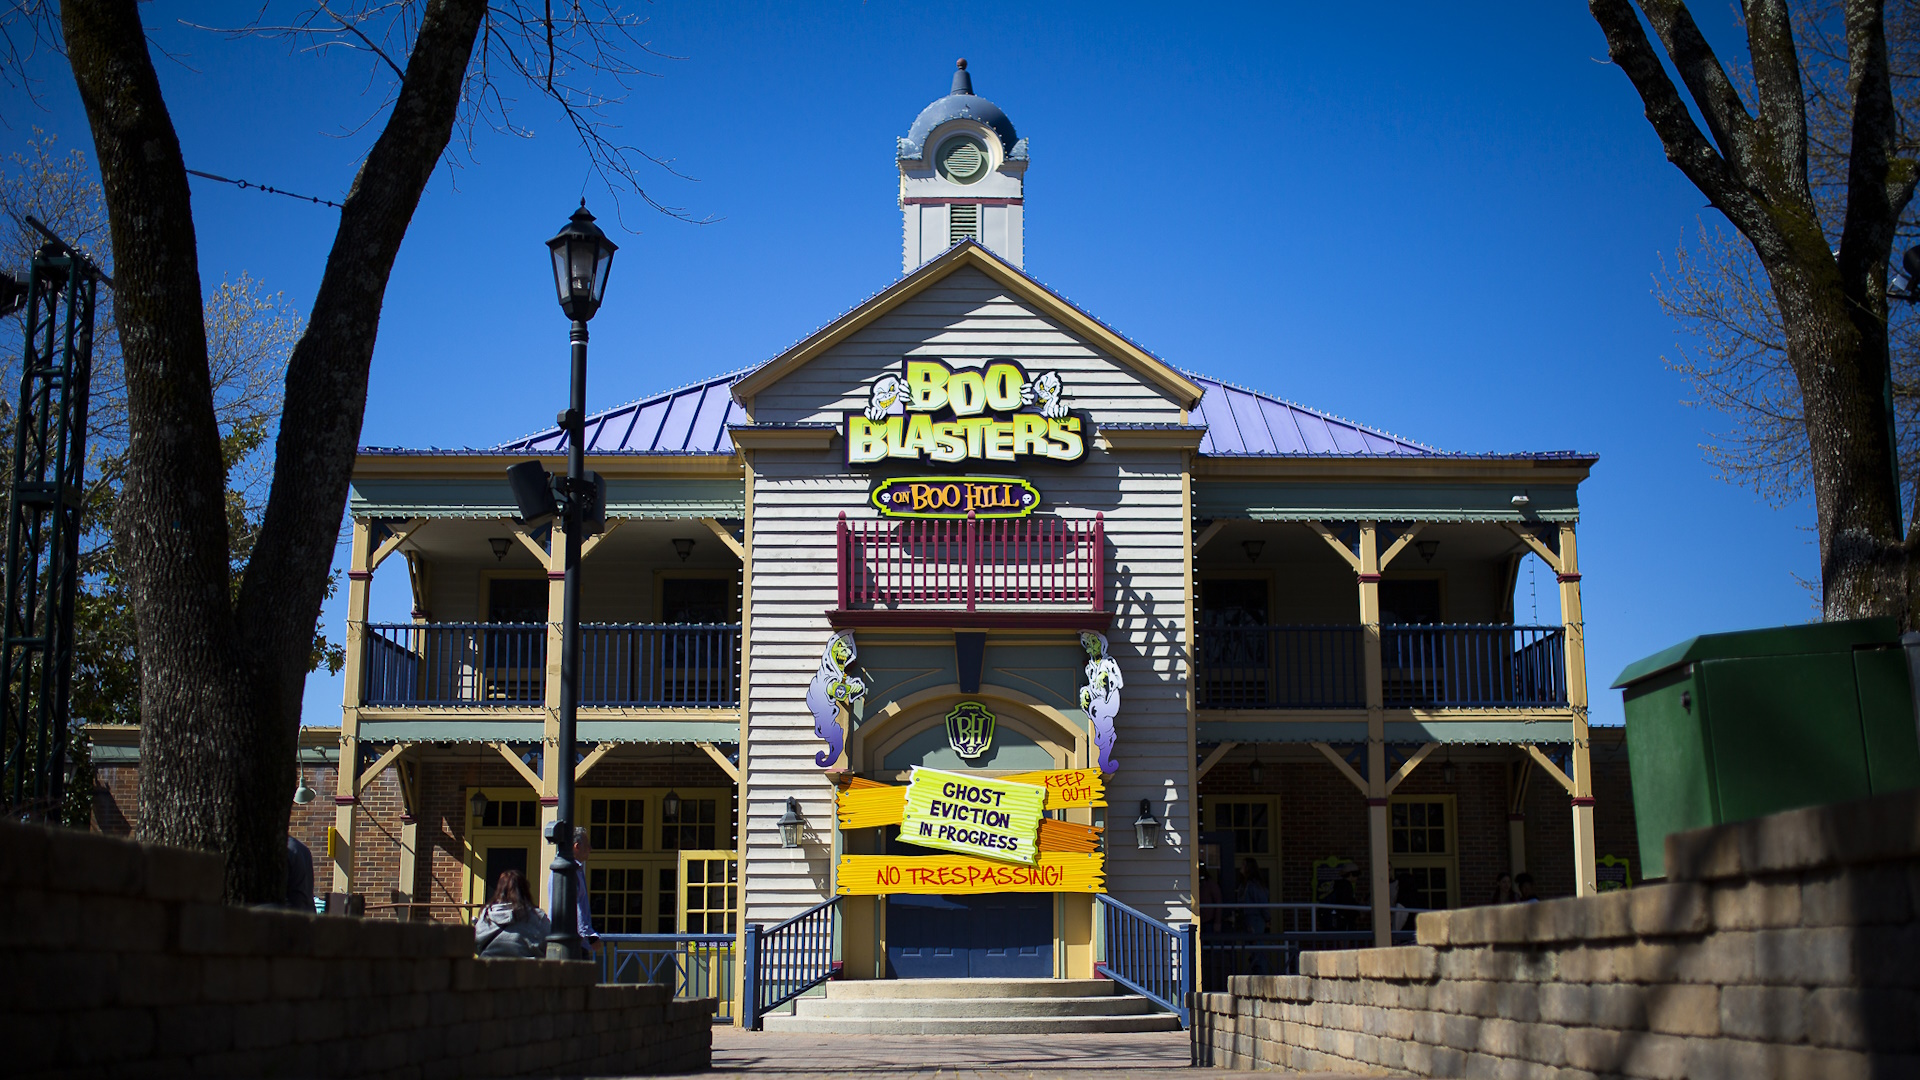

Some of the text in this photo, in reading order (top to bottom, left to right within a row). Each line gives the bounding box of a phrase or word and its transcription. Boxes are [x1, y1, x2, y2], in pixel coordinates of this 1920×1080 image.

[906, 361, 1026, 416] BOO
[849, 414, 1084, 463] BLASTERS
[892, 483, 1020, 512] ON BOO HILL
[942, 782, 1006, 807] GHOST
[1044, 771, 1085, 789] KEEP
[1062, 785, 1091, 802] OUT!
[930, 800, 1011, 829] EVICTION
[919, 821, 1018, 851] IN PROGRESS
[877, 865, 1063, 887] NO TRESPASSING!
